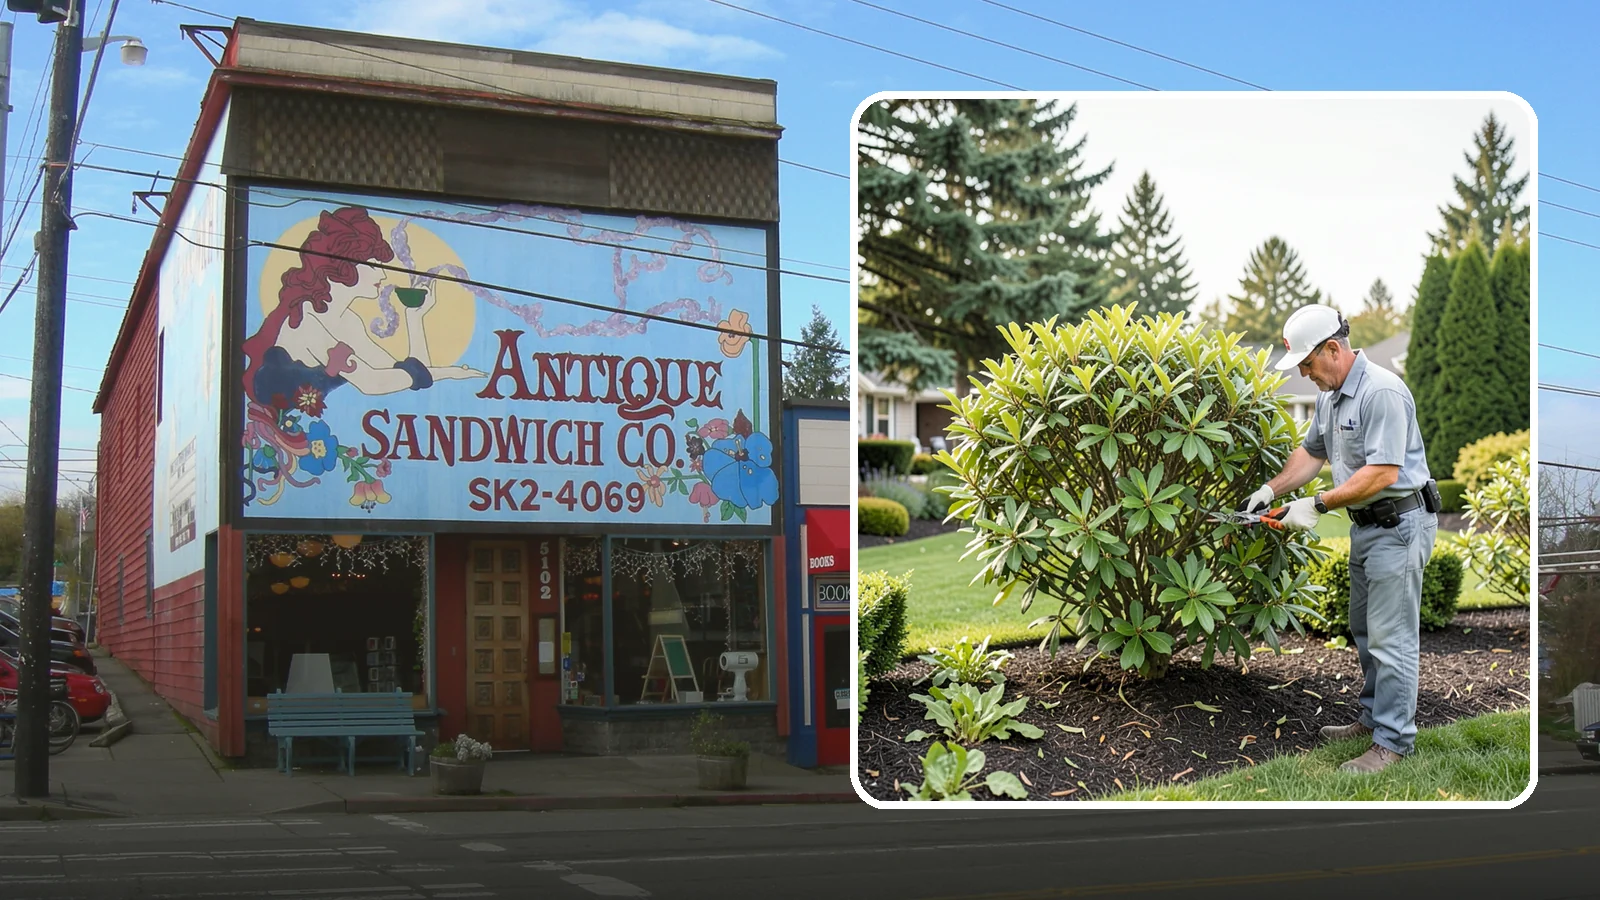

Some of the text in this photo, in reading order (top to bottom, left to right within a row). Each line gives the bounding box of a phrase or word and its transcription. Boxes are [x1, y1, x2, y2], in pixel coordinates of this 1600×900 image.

[475, 329, 723, 420] ANTIQUE
[361, 408, 685, 469] SANDWICH CO.
[468, 477, 646, 513] SK2-4069
[539, 541, 552, 600] 5102
[809, 555, 834, 568] BOOKS
